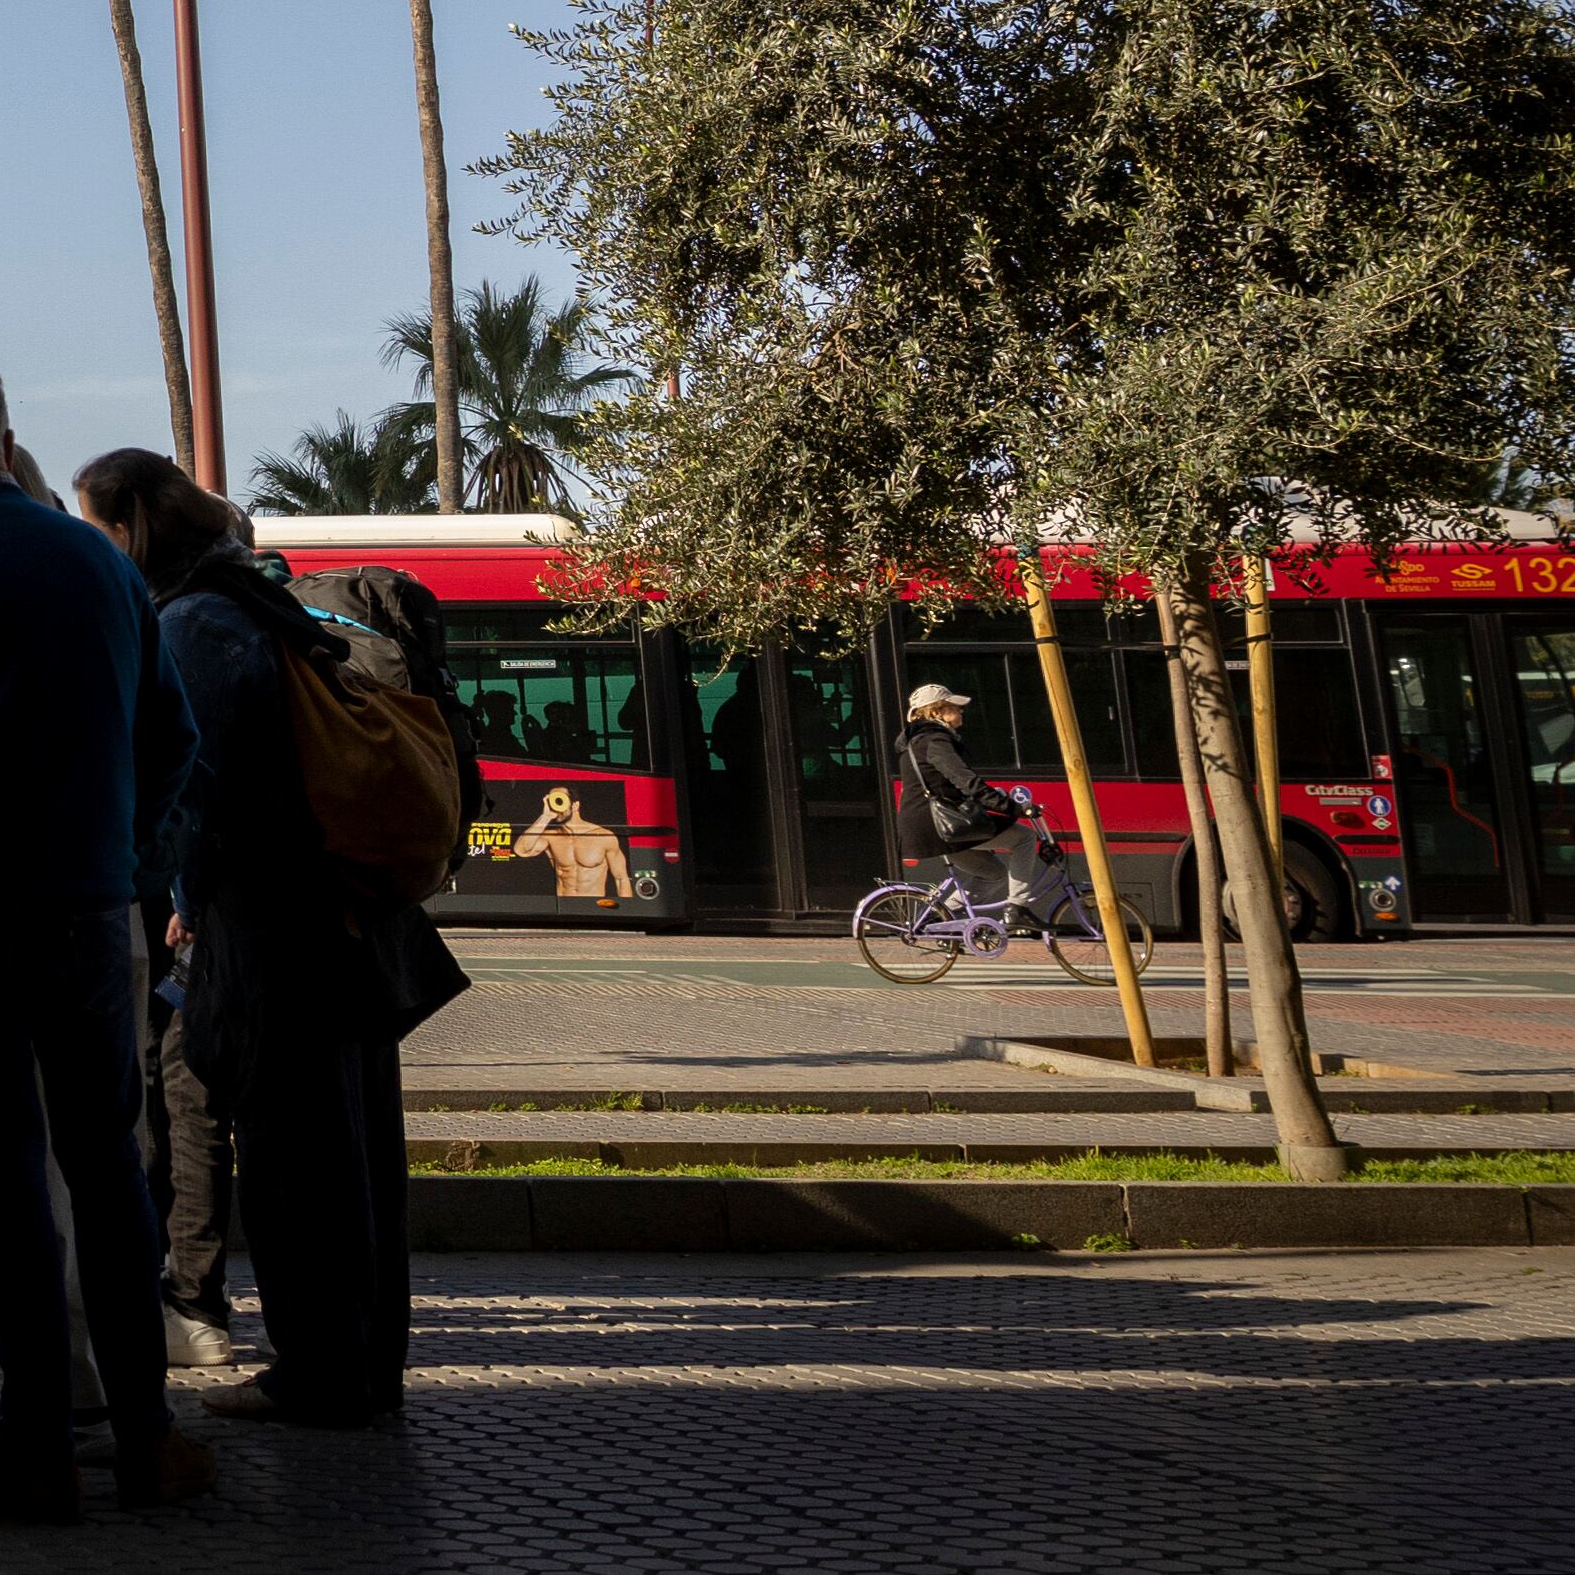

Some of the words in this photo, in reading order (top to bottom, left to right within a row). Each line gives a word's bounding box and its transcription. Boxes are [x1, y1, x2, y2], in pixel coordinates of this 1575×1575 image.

[1504, 557, 1575, 593] 132
[1451, 580, 1496, 588] TUSSAM
[1304, 785, 1374, 796] CityClass
